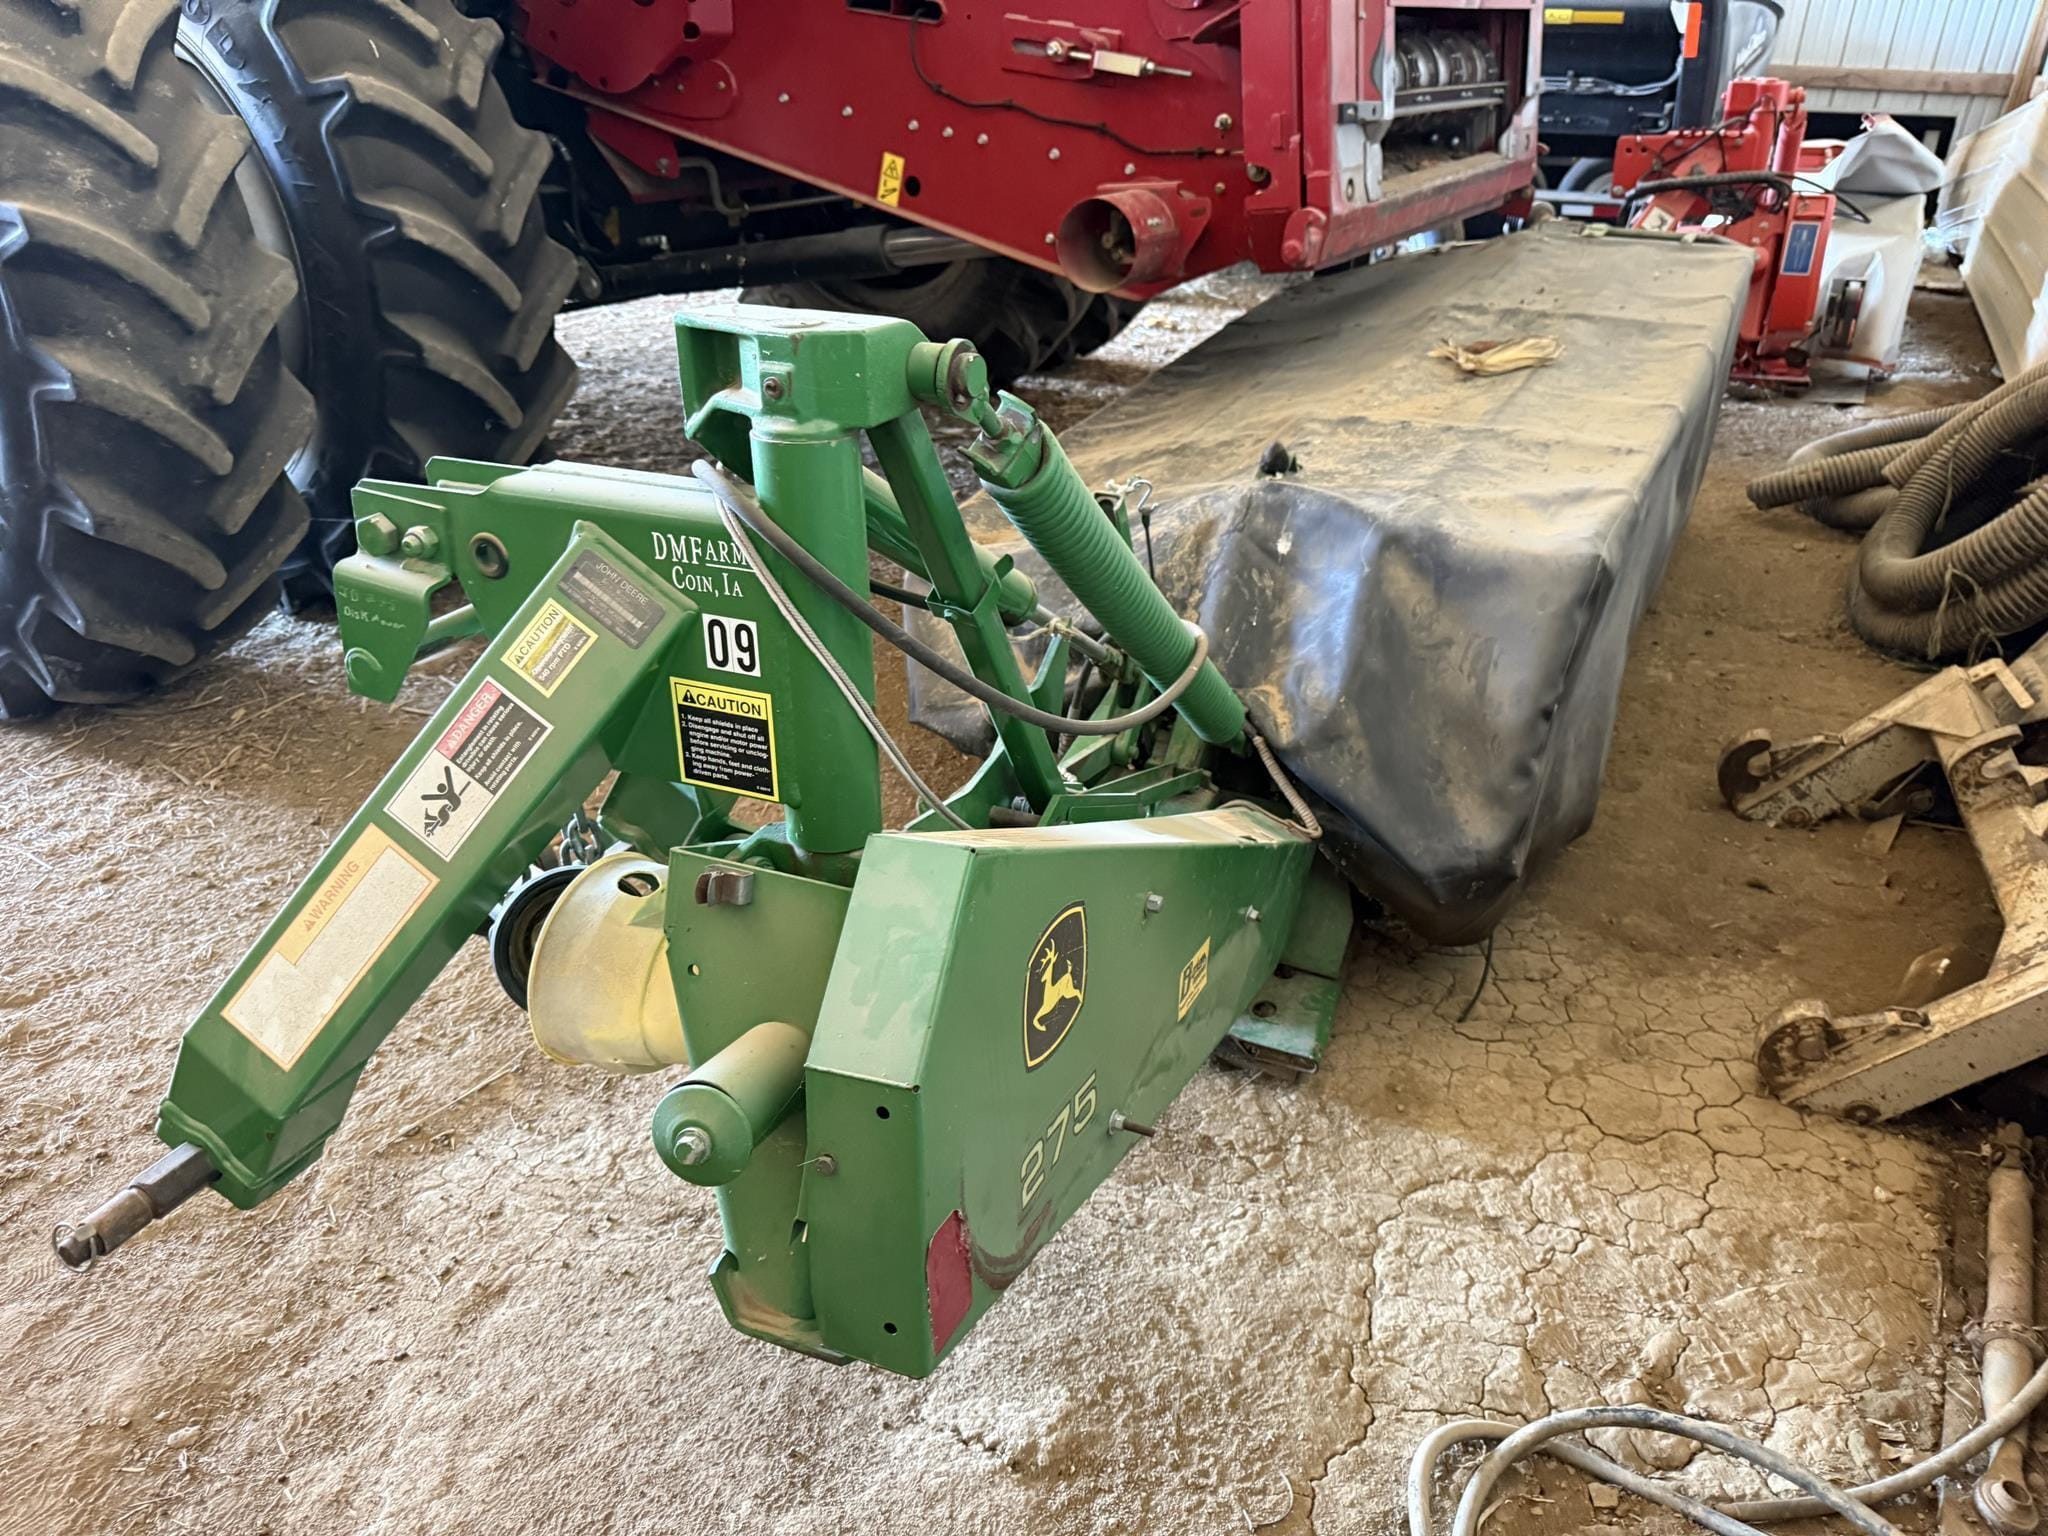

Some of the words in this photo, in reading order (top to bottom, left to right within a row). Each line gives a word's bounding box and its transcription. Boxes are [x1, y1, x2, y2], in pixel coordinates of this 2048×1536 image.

[596, 562, 620, 583] JOHN
[620, 581, 648, 605] DEERE
[517, 608, 559, 657] CAUTION
[708, 619, 756, 672] 09
[557, 642, 570, 657] PTO
[454, 693, 492, 739] DANGER
[696, 692, 761, 716] CAUTION
[456, 730, 484, 763] Entanglement
[486, 705, 504, 725] rotating
[478, 736, 487, 746] can
[486, 721, 498, 736] cause
[498, 703, 513, 720] serious
[687, 714, 702, 723] Keep
[712, 718, 733, 728] shields
[688, 722, 719, 734] Disengage
[720, 728, 731, 736] and
[732, 730, 746, 738] shut
[689, 730, 708, 739] engine
[710, 734, 728, 742] and/or
[729, 738, 747, 746] motor
[749, 742, 767, 751] power
[689, 738, 708, 746] before
[709, 741, 737, 753] servicing
[475, 765, 487, 779] Keep
[490, 741, 505, 758] shields
[484, 771, 496, 785] Avoid
[495, 752, 511, 771] contact
[511, 741, 520, 752] with
[691, 752, 707, 761] Keep
[741, 762, 752, 770] and
[693, 768, 711, 776] driven
[702, 763, 718, 771] away
[489, 770, 506, 790] rotating
[309, 860, 360, 921] WARNING
[1020, 1070, 1097, 1210] 275
